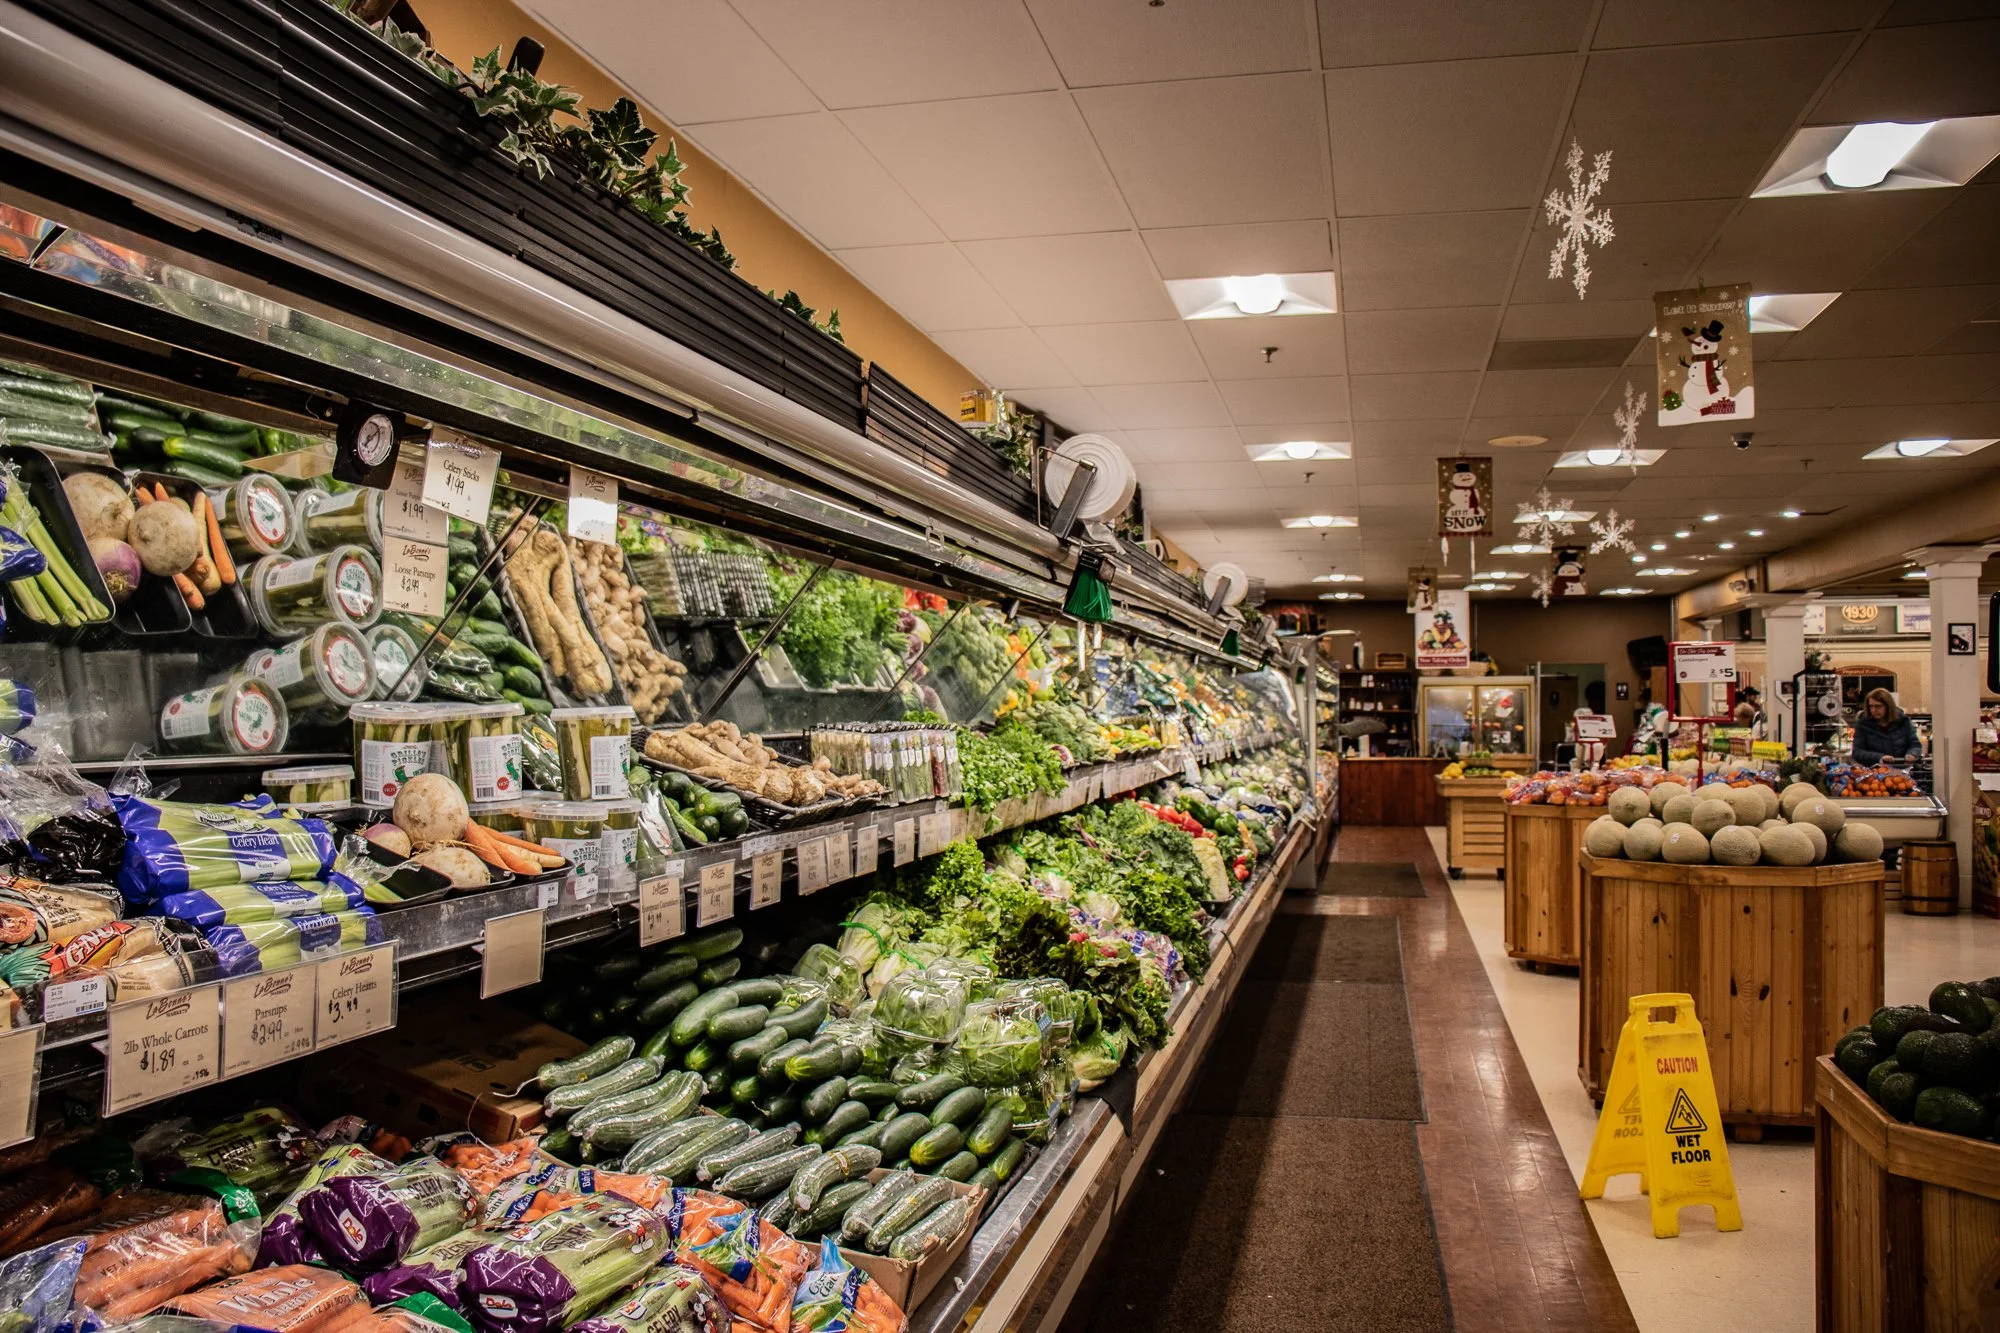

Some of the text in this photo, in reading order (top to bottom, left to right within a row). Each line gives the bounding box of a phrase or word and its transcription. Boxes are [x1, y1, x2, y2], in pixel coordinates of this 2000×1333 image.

[1663, 304, 1684, 316] Let
[1686, 303, 1697, 314] It
[443, 459, 463, 478] Celery
[462, 466, 480, 482] Sticks
[402, 501, 424, 521] $1.99
[1444, 516, 1487, 529] SNOW
[394, 563, 436, 582] Loose Parsnips
[1846, 606, 1874, 618] 1930
[232, 834, 280, 849] Celery Heart
[81, 982, 98, 993] $2.99
[332, 980, 378, 1000] Celery Hearts
[255, 1004, 288, 1020] Parsnips
[123, 1024, 209, 1055] 2lb Whole Carrots
[251, 1019, 283, 1046] $2.99
[140, 1047, 176, 1075] $1.89
[1656, 1057, 1699, 1075] CAUTION
[1676, 1134, 1701, 1148] WET
[1671, 1150, 1711, 1164] FLOOR
[342, 1215, 364, 1245] Dole
[216, 1277, 316, 1313] Whole
[264, 1288, 321, 1318] CARROTS
[485, 1297, 513, 1309] Dole
